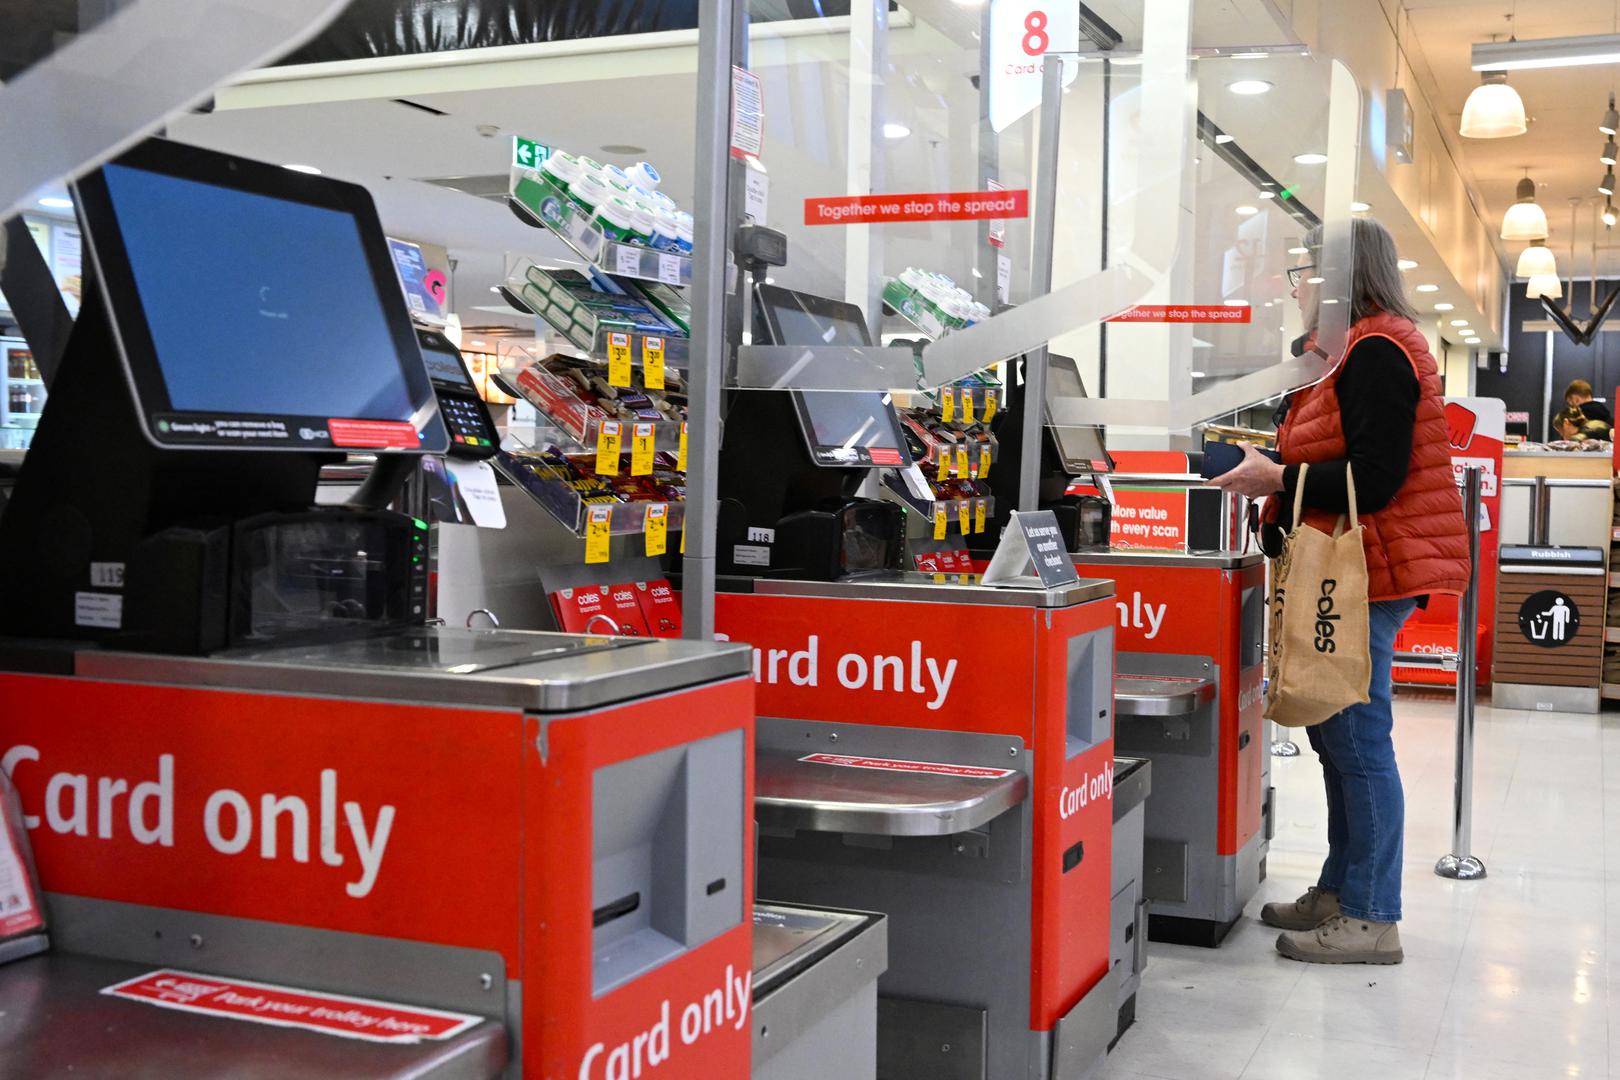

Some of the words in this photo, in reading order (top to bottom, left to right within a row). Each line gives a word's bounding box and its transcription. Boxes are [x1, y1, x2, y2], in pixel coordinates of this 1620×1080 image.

[1021, 10, 1049, 56] 8
[1005, 64, 1035, 75] Card
[817, 203, 876, 220] Together
[879, 203, 900, 214] we
[904, 200, 934, 216] stop
[937, 199, 961, 213] the
[964, 198, 1015, 215] spread
[1168, 309, 1189, 319] stop
[1191, 309, 1206, 318] the
[1208, 309, 1242, 319] spread
[1111, 504, 1136, 519] More
[1138, 506, 1168, 520] value
[751, 532, 771, 543] 118
[1122, 524, 1151, 538] every
[1152, 524, 1179, 538] scan
[1531, 550, 1572, 559] Rubbish
[577, 593, 600, 605] coles
[613, 590, 633, 602] coles
[651, 586, 671, 597] coles
[1116, 591, 1167, 639] nly
[1314, 578, 1341, 654] coles
[836, 640, 958, 710] only
[1060, 772, 1088, 820] Card
[1090, 760, 1113, 800] only
[203, 768, 396, 898] only
[214, 991, 264, 1008] Park
[262, 998, 313, 1016] your
[312, 1005, 377, 1028] trolley
[376, 1014, 431, 1034] here
[680, 964, 751, 1045] only
